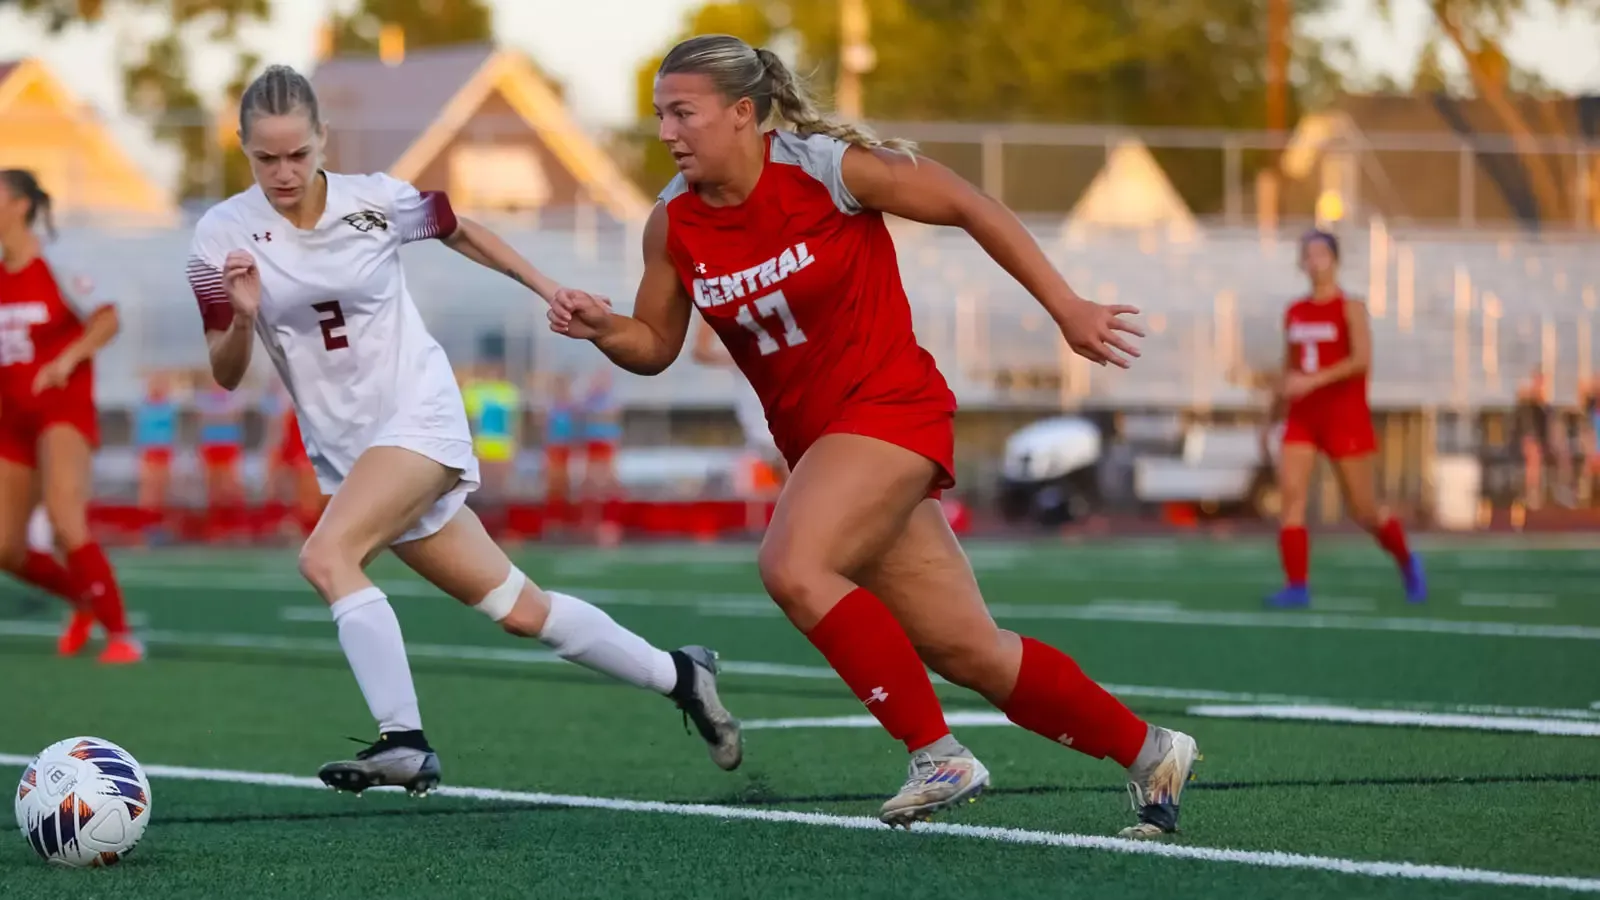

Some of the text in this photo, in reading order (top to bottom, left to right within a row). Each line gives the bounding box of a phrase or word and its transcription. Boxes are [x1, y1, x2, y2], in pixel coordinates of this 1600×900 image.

[692, 242, 816, 309] CENTRAL
[311, 300, 349, 352] 2
[734, 289, 808, 357] 17
